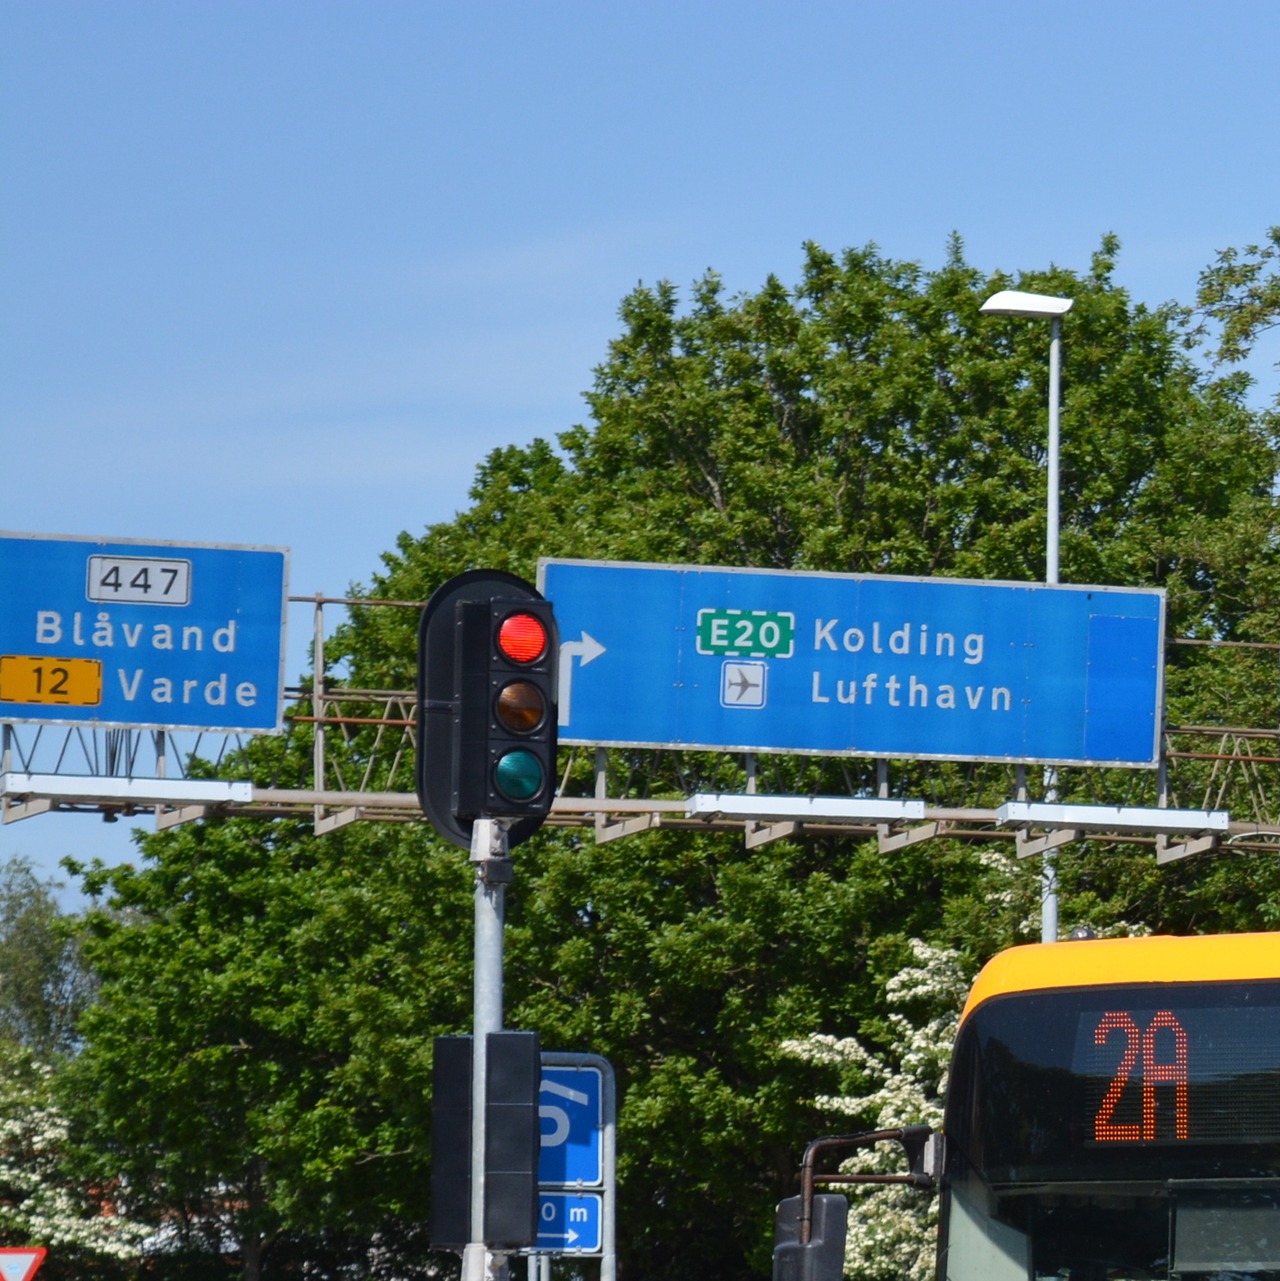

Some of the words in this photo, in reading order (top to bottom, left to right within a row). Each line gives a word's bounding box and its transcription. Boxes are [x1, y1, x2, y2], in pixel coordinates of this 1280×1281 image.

[99, 565, 180, 597] 447
[35, 610, 237, 653] Blåvand
[709, 618, 782, 649] E20
[812, 618, 986, 665] Kolding
[33, 666, 70, 696] 12
[118, 668, 258, 708] Varde
[811, 670, 1013, 712] Lufthavn
[1093, 1010, 1189, 1142] 2A
